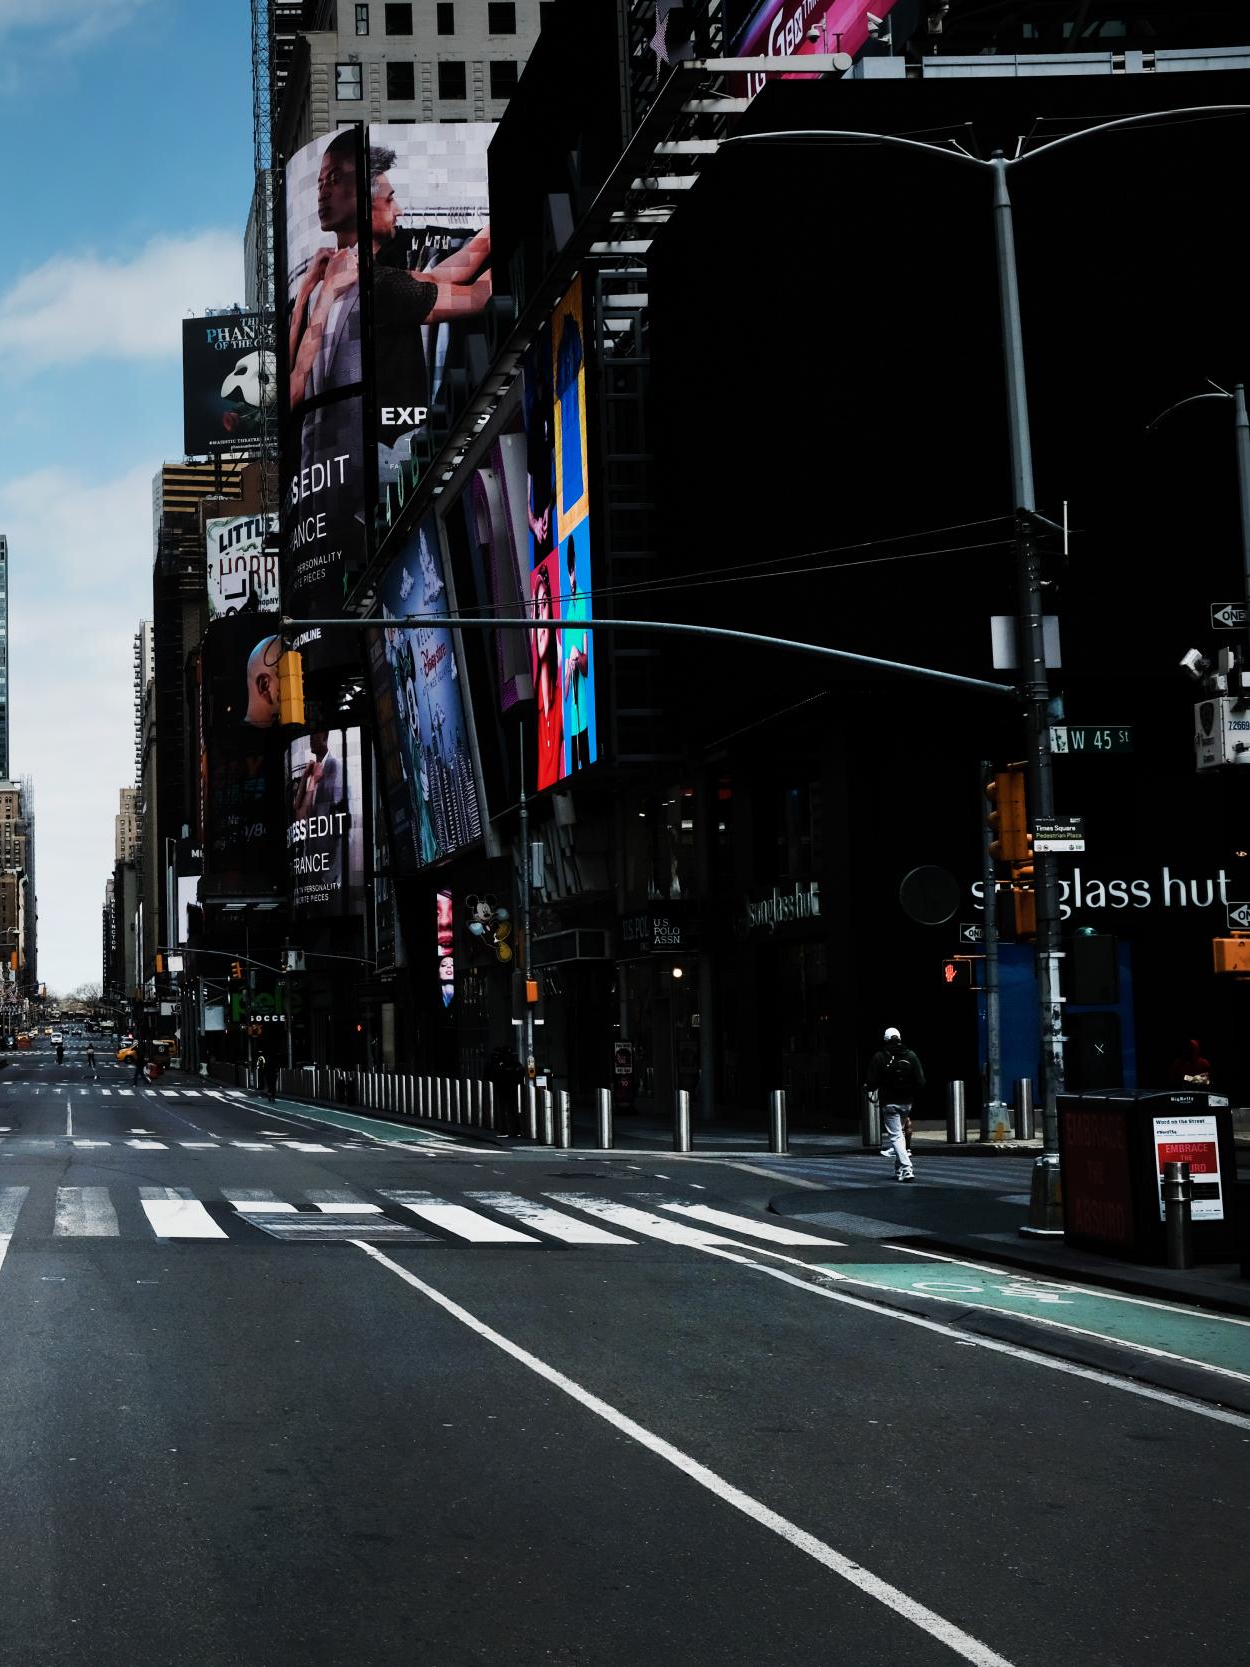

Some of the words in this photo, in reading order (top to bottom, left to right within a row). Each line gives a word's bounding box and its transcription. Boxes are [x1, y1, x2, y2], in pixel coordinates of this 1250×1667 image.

[215, 341, 229, 350] OF
[1222, 611, 1246, 621] ONE
[1071, 731, 1085, 749] W
[1094, 731, 1113, 749] 45
[1118, 730, 1130, 743] St
[1054, 824, 1076, 832] Square
[1162, 866, 1232, 908] hut
[653, 927, 681, 936] POLO
[1165, 1144, 1209, 1153] EMBRACE
[1189, 1164, 1207, 1173] URD
